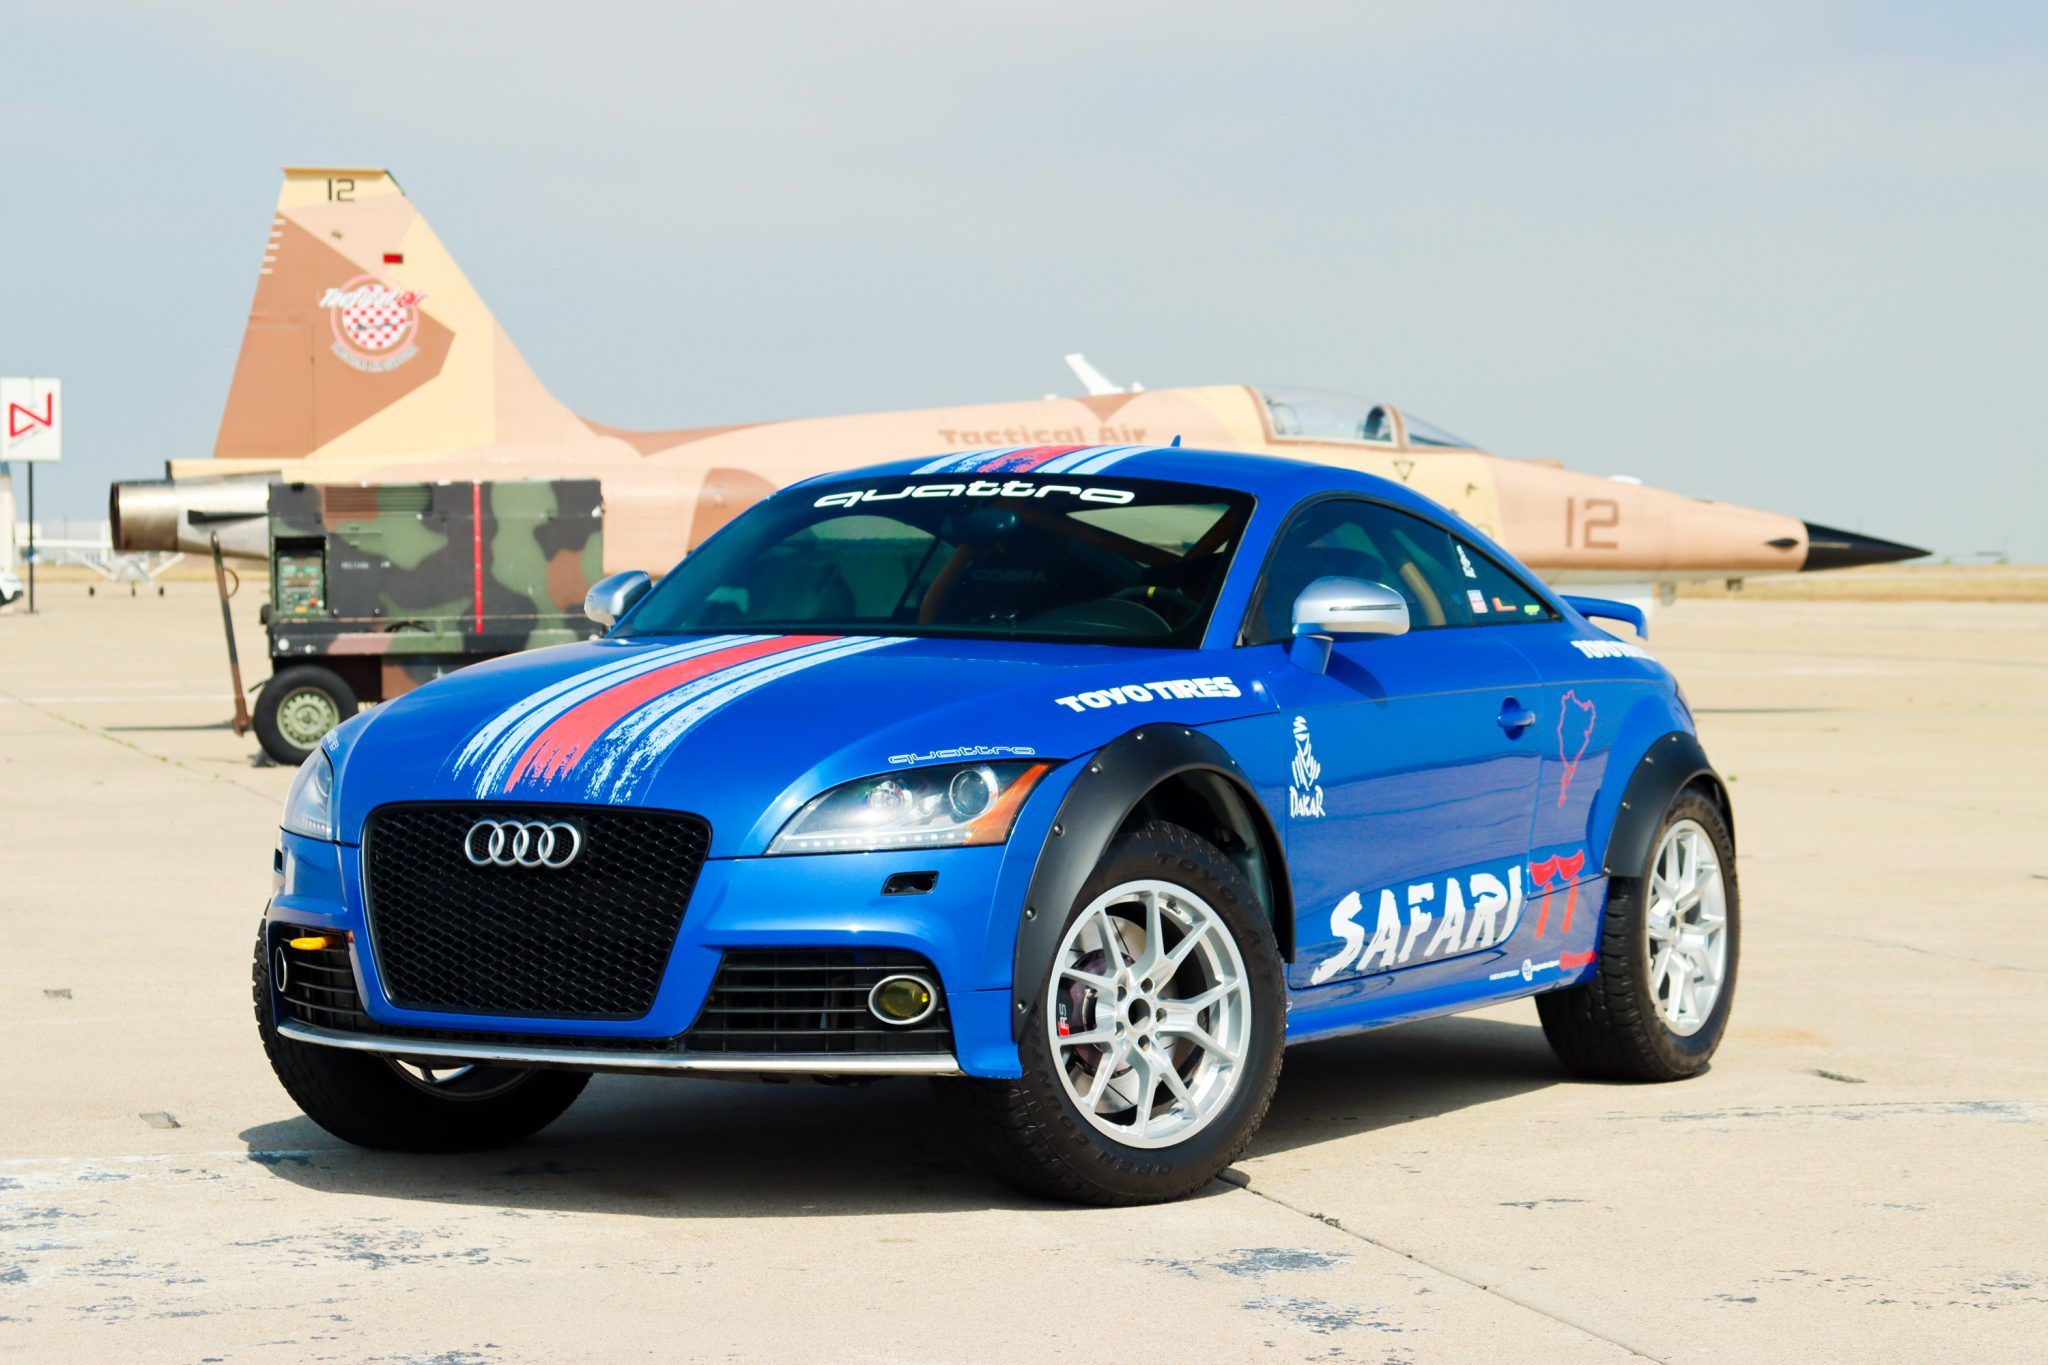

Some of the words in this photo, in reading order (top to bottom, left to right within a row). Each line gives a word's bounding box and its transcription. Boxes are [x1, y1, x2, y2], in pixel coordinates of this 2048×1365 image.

[327, 178, 355, 202] 12
[937, 425, 1086, 445] Tactical
[1097, 423, 1147, 443] Air
[813, 479, 1135, 508] quattro
[1565, 496, 1620, 549] 12
[1054, 684, 1153, 712] TOYO
[1143, 676, 1242, 699] TIRES
[888, 745, 1035, 764] quattro
[1310, 865, 1523, 985] SAFARI
